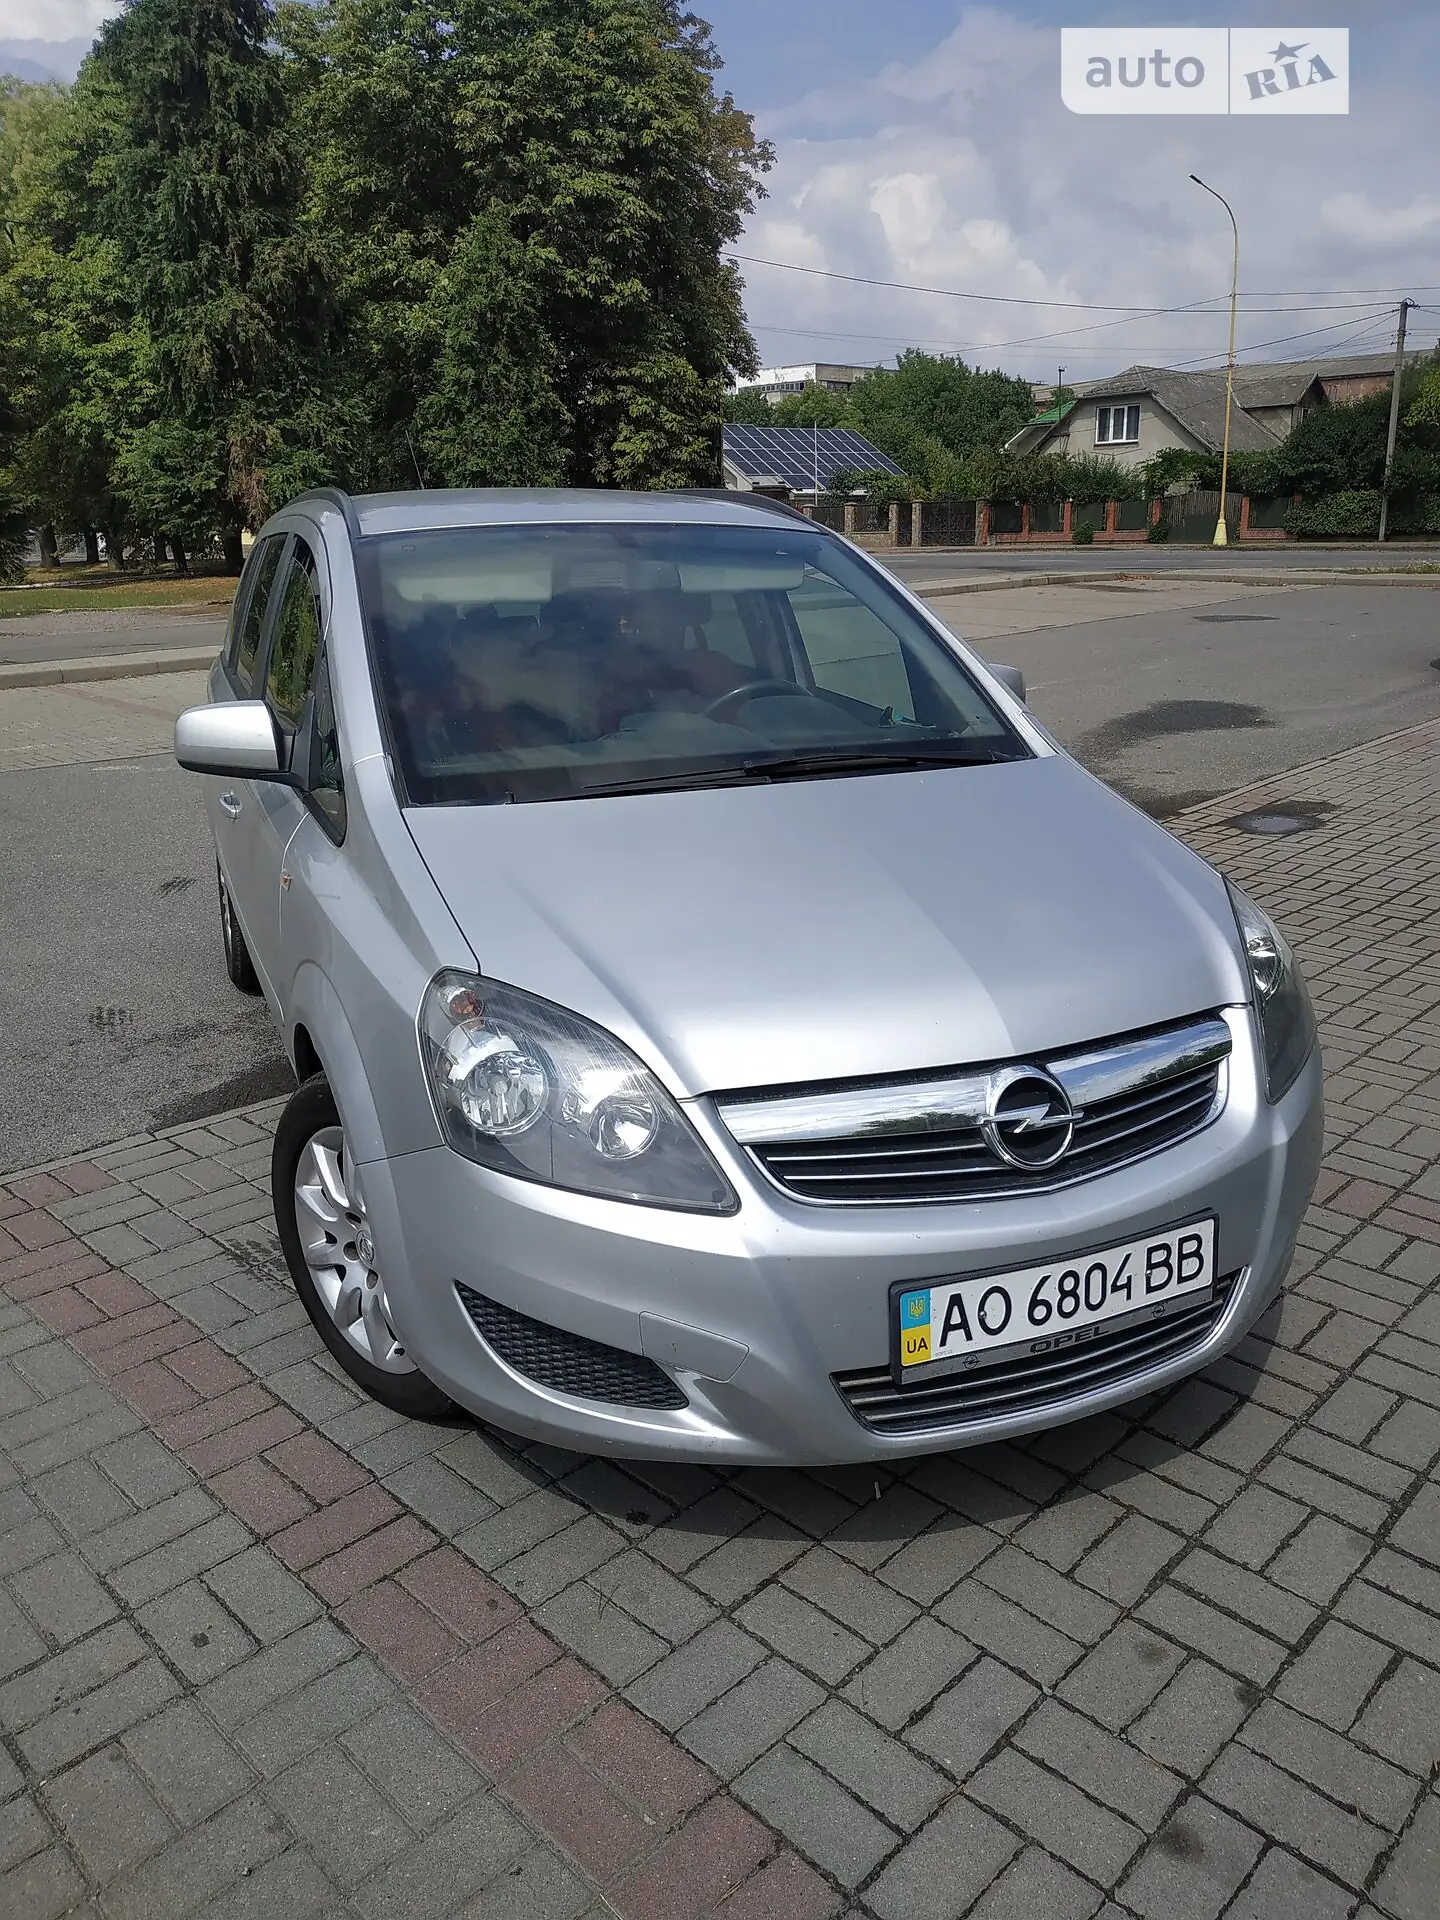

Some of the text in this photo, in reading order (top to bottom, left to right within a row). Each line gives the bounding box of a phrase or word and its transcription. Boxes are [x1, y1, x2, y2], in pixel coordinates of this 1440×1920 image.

[939, 1233, 1204, 1347] AO 6804 BB
[906, 1336, 928, 1353] UA
[1029, 1325, 1110, 1353] OPEL
